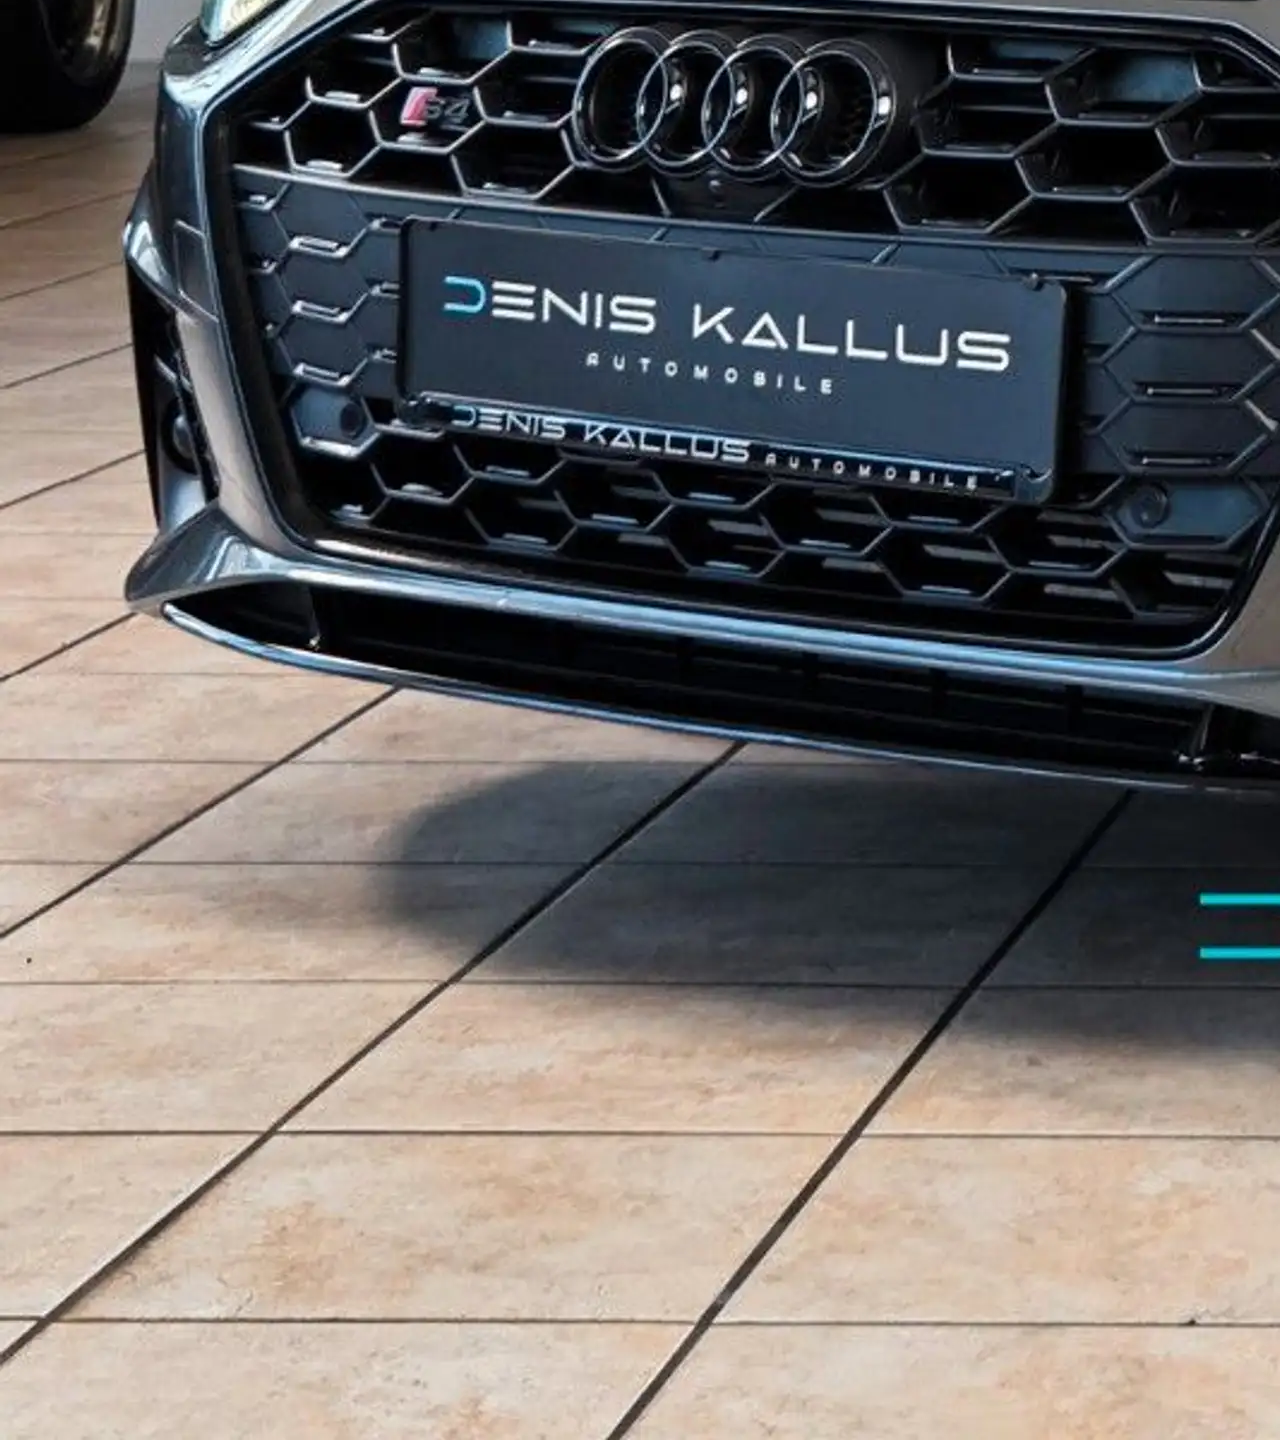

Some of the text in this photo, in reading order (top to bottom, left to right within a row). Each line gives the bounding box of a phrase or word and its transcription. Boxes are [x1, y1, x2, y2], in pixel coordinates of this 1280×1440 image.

[444, 276, 1011, 372] DENIS KALLUS
[586, 352, 833, 394] AUTOMOBILE
[452, 405, 978, 491] DENIS KALLUS AUTOMOBILE
